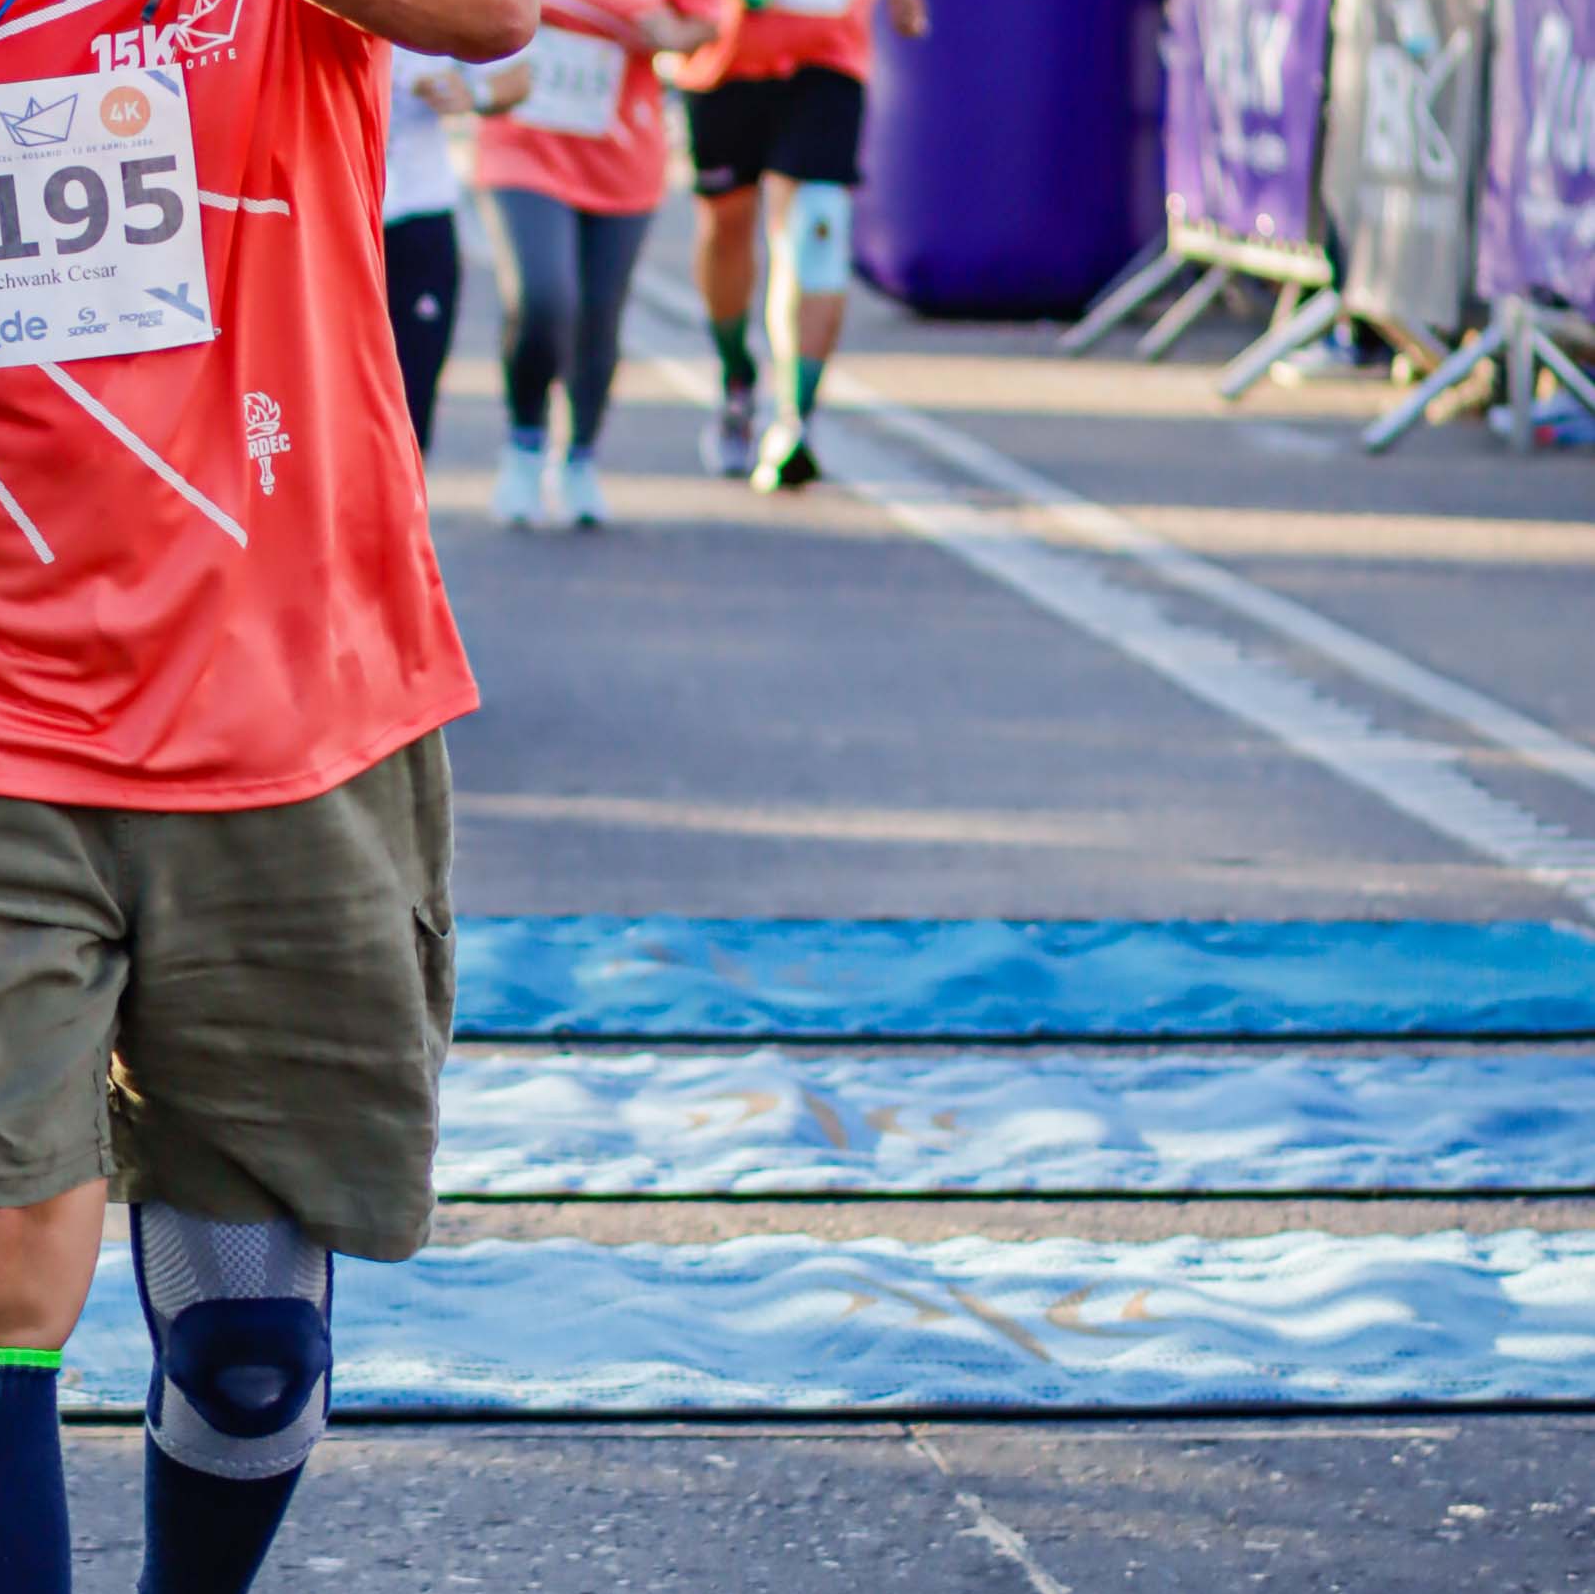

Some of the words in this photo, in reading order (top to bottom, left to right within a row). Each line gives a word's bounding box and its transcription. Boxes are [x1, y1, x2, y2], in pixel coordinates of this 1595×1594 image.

[91, 23, 178, 72] 15K
[185, 47, 238, 70] ORTE
[109, 100, 142, 123] 4K
[67, 263, 118, 282] Cesar
